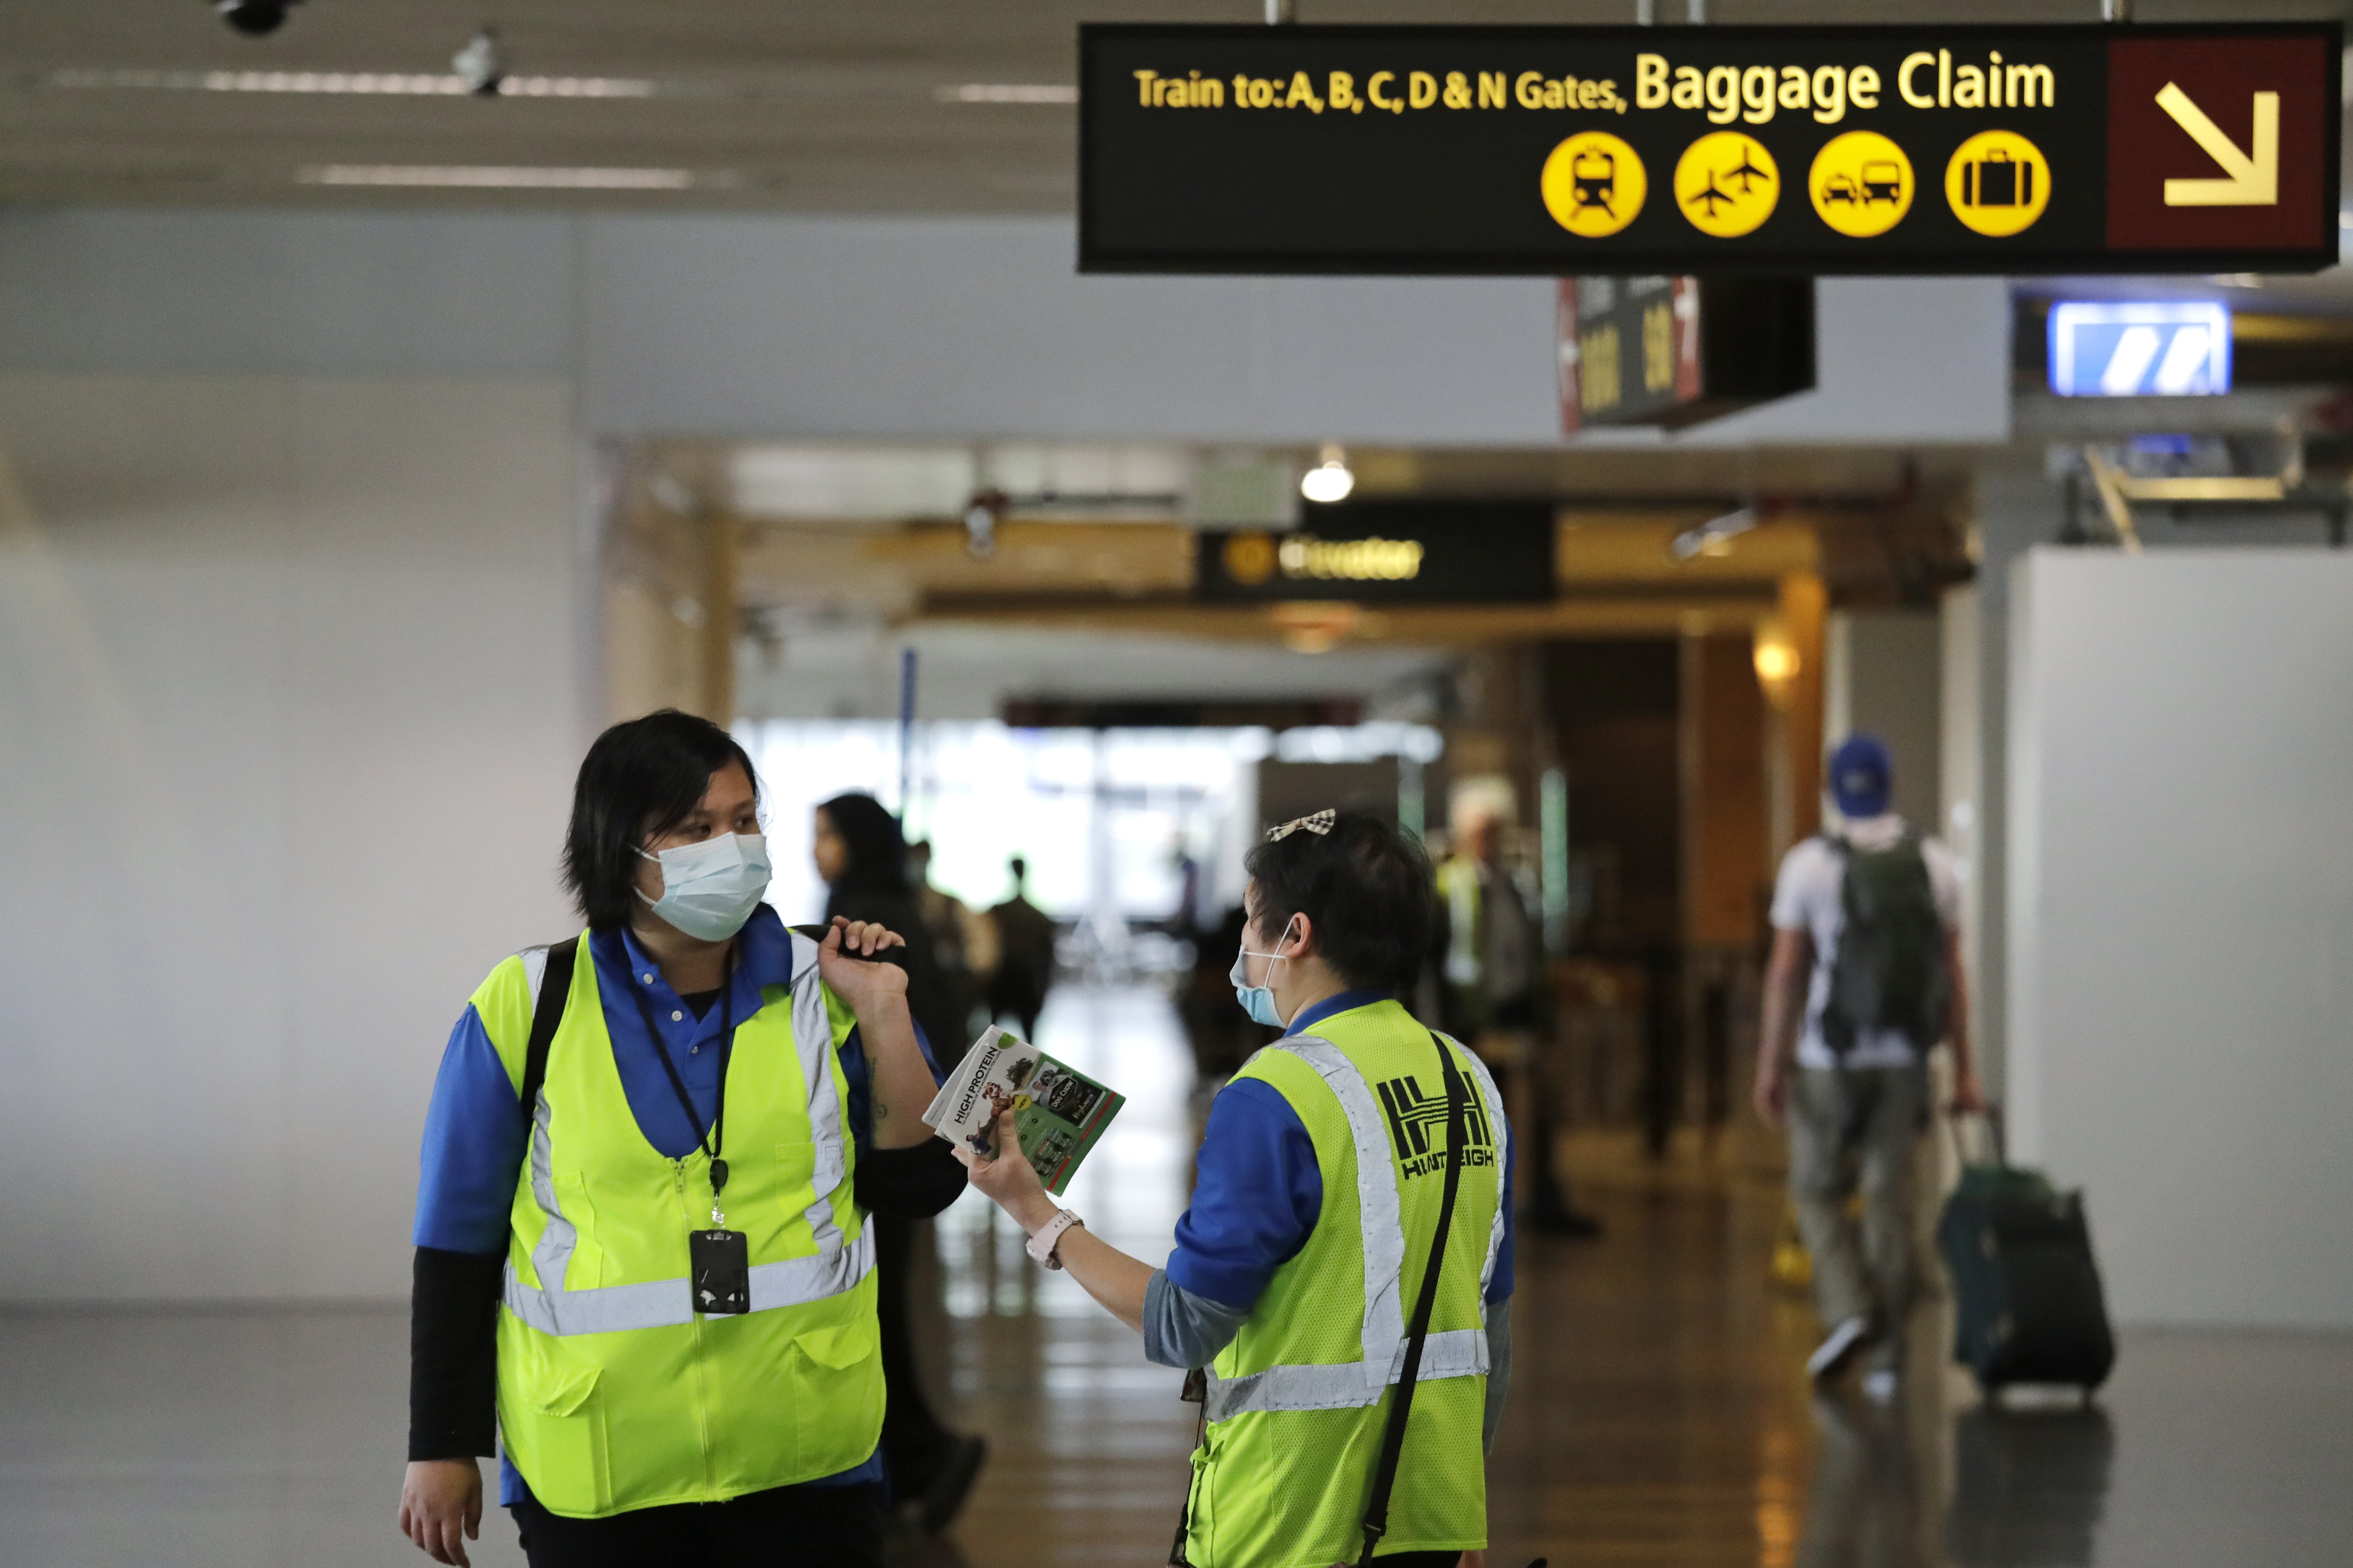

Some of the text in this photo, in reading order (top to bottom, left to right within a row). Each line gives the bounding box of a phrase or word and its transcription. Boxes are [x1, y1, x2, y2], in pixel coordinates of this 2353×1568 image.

[1134, 48, 2054, 124] Train to: A, B, C, D & N Gates, Baggage Claim
[954, 1046, 998, 1124] HIGH PROTEIN
[1051, 1080, 1073, 1108] DOG CHOW
[1018, 1096, 1029, 1109] NEW!
[1402, 1149, 1494, 1180] HUNTIGH
